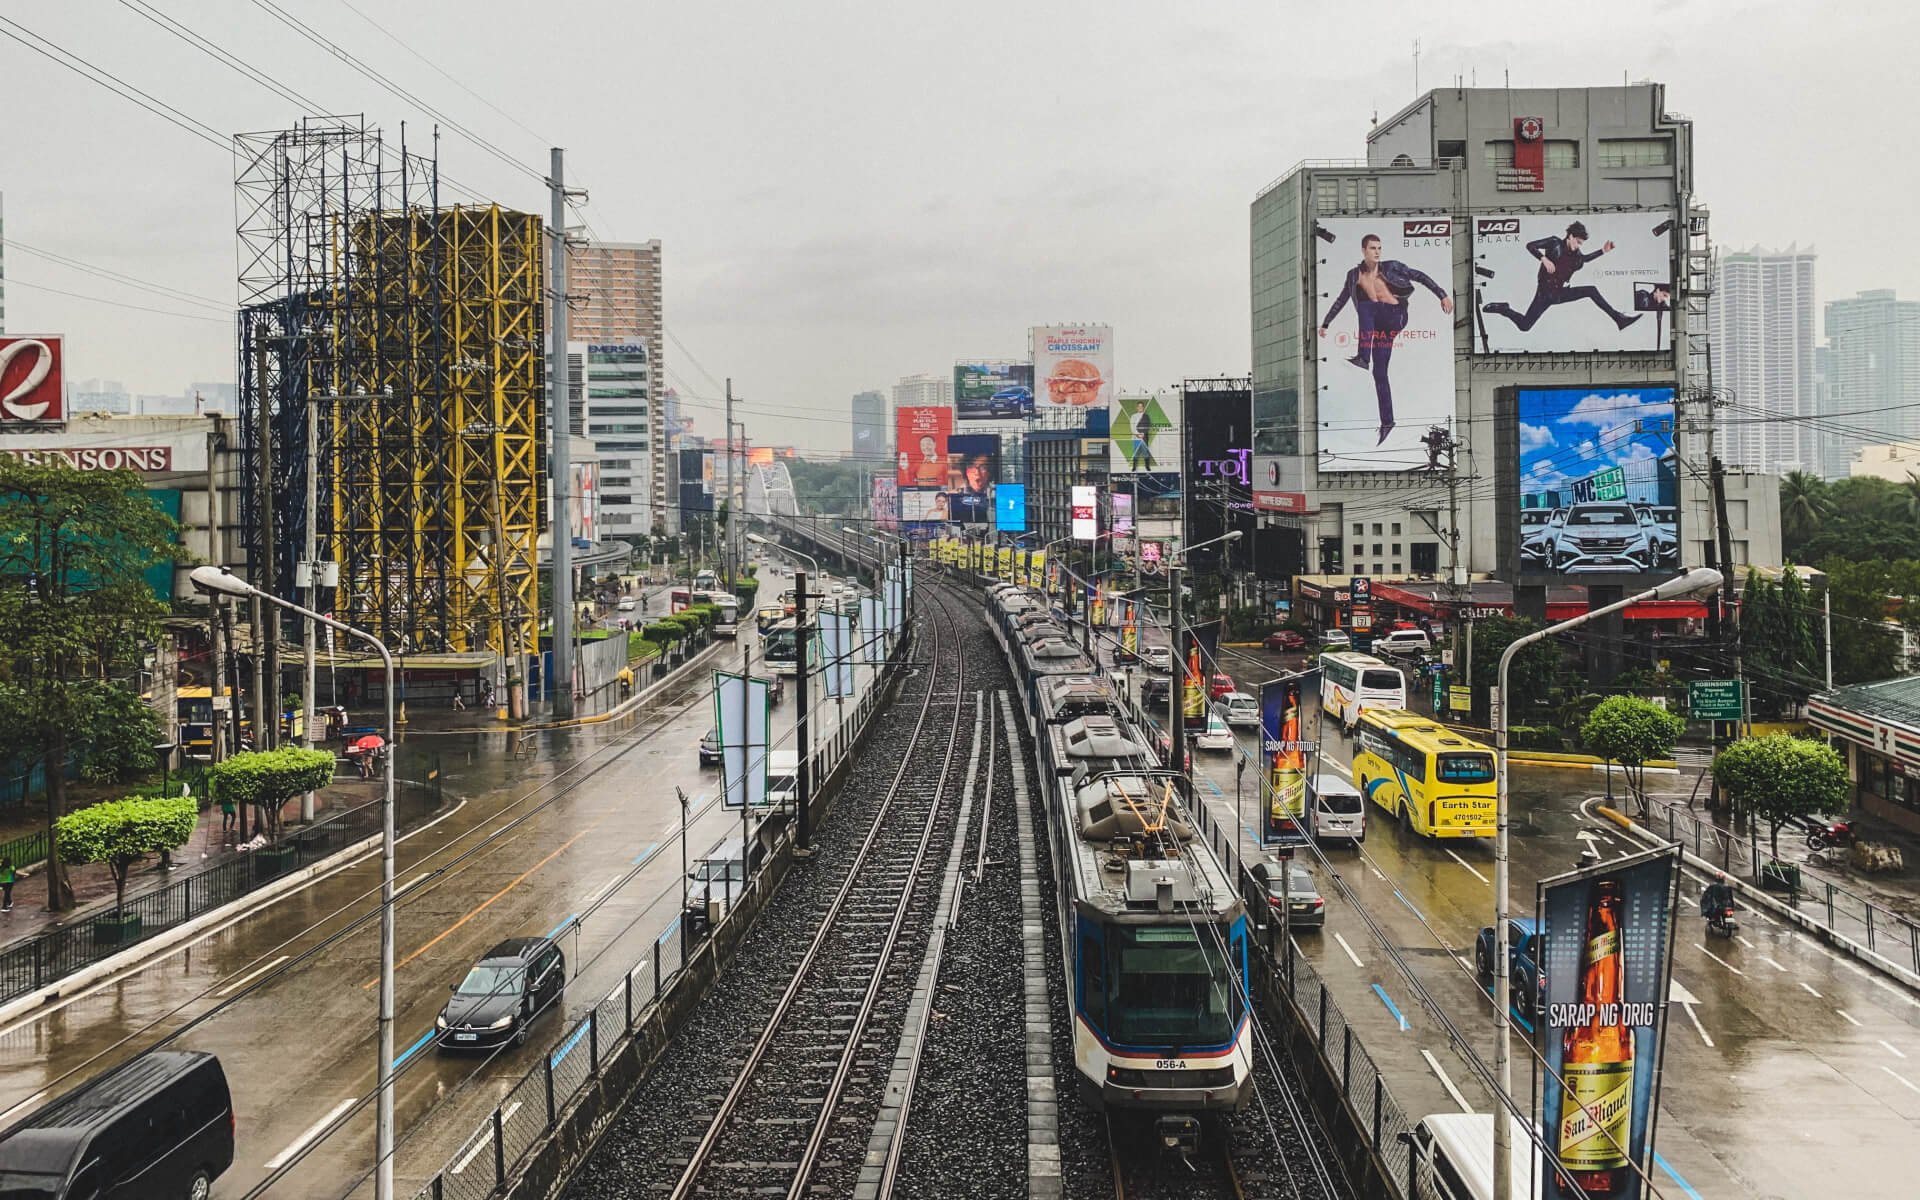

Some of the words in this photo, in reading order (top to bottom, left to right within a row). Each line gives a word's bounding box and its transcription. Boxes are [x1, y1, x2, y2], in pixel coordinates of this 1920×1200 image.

[1405, 223, 1449, 235] JAG
[1478, 221, 1517, 232] JAG
[1403, 239, 1451, 248] BLACK
[1477, 234, 1519, 244] BLACK
[1353, 330, 1386, 340] ULTRA
[1389, 330, 1436, 340] STRETCH
[1574, 480, 1597, 503] MC
[1442, 801, 1469, 809] Earth
[1472, 801, 1491, 809] Star
[1550, 1002, 1596, 1028] SARAP
[1599, 1002, 1619, 1027] NG
[1622, 1002, 1654, 1027] ORIG
[1156, 1060, 1187, 1069] 056-A
[1564, 1118, 1586, 1140] San
[1587, 1087, 1628, 1129] Miguel
